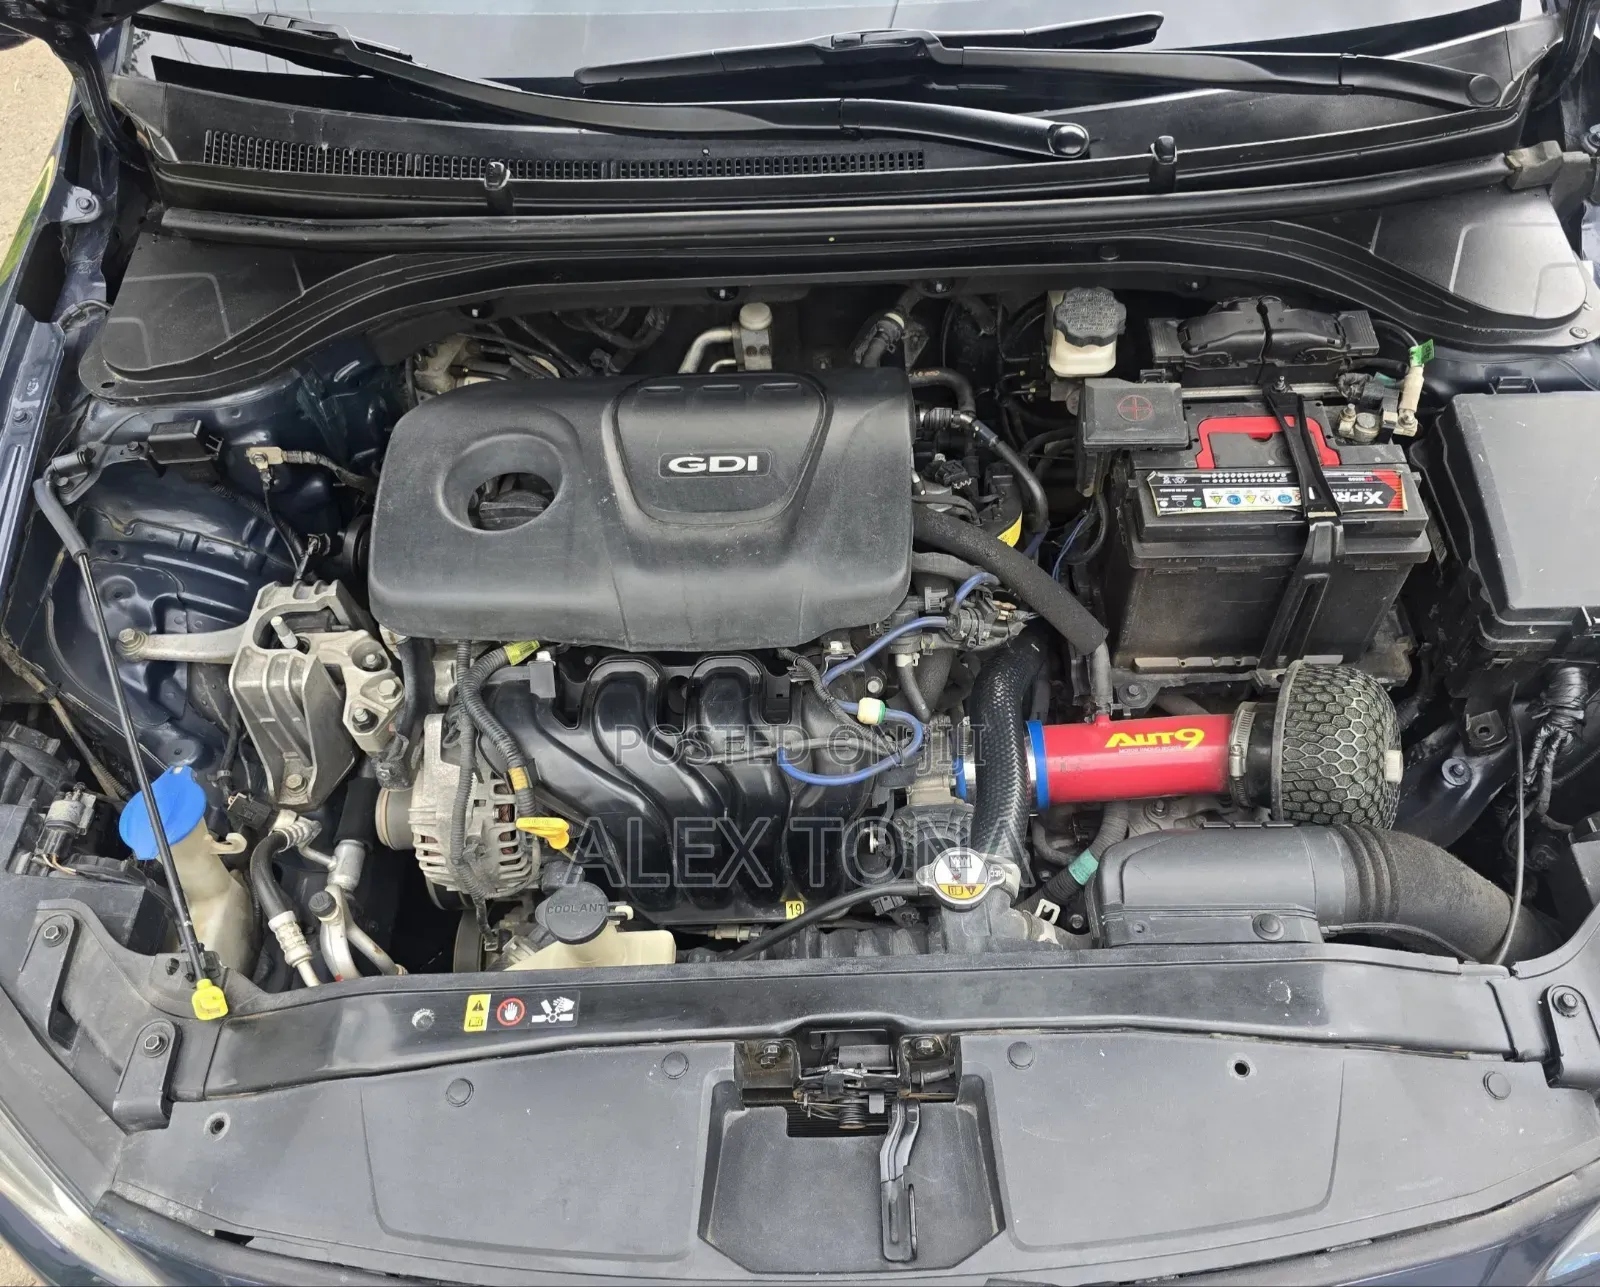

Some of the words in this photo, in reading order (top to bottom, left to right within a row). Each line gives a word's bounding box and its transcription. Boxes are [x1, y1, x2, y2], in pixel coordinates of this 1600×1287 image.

[668, 455, 758, 473] GDI
[547, 903, 606, 915] COOLANT
[788, 903, 802, 916] 19
